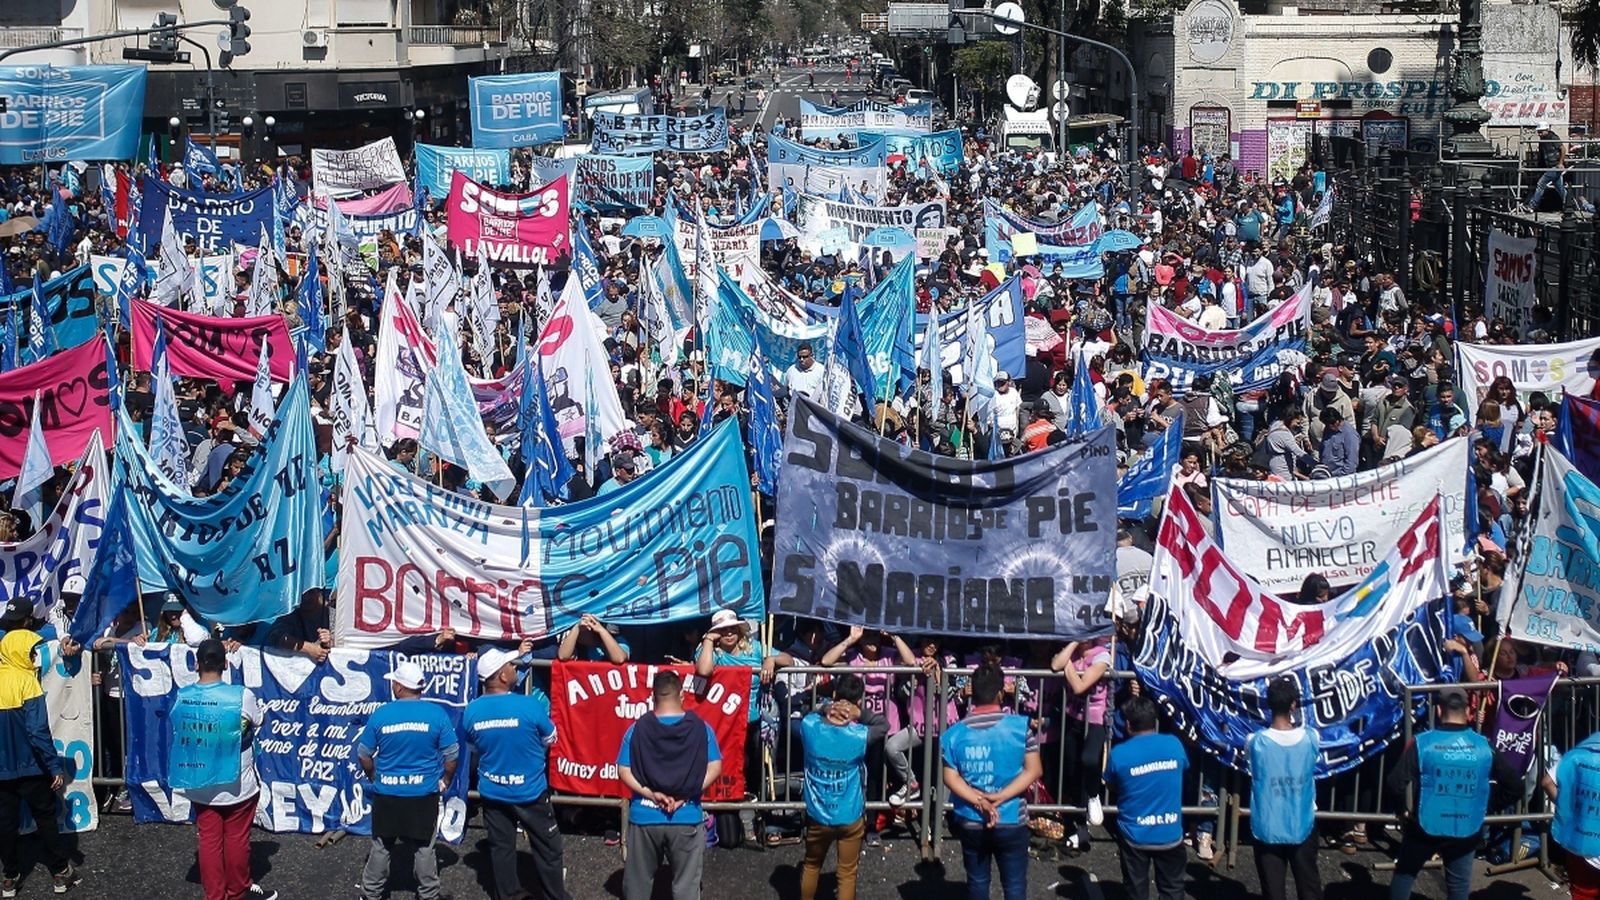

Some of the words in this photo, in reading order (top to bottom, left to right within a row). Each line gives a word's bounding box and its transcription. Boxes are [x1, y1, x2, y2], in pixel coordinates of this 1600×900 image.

[491, 91, 552, 104] BARRIOS
[1247, 82, 1302, 100] DI
[1308, 80, 1501, 100] PROSPEO
[3, 94, 87, 109] BARRIOS
[492, 102, 521, 120] DE
[526, 101, 552, 118] PIE
[848, 100, 888, 113] SOMOS
[2, 110, 40, 128] DE
[44, 109, 84, 127] PIE
[614, 114, 716, 132] BARRIOS
[512, 133, 539, 143] CABA
[624, 133, 654, 145] DE
[666, 134, 701, 150] PIE
[443, 155, 495, 168] BARRIOS
[577, 158, 616, 172] SOMOS
[779, 149, 883, 166] BARRIOS
[472, 170, 498, 184] PIE
[620, 172, 633, 189] DE
[825, 202, 914, 225] MOVIMIENTO
[197, 217, 224, 235] DE
[1150, 332, 1251, 364] BARRIOS
[1275, 316, 1305, 346] PIE
[1080, 444, 1110, 459] PINO
[1226, 493, 1280, 518] COPA
[1290, 492, 1317, 515] DE
[1328, 482, 1400, 510] LECHE
[833, 481, 984, 541] BARRIOS
[1280, 515, 1355, 547] NUEVO
[1266, 540, 1378, 570] AMANECER
[306, 722, 319, 738] a
[323, 721, 350, 739] mi
[298, 739, 319, 758] de
[1443, 752, 1477, 761] adidas
[556, 757, 596, 780] Virrey
[599, 763, 620, 780] del
